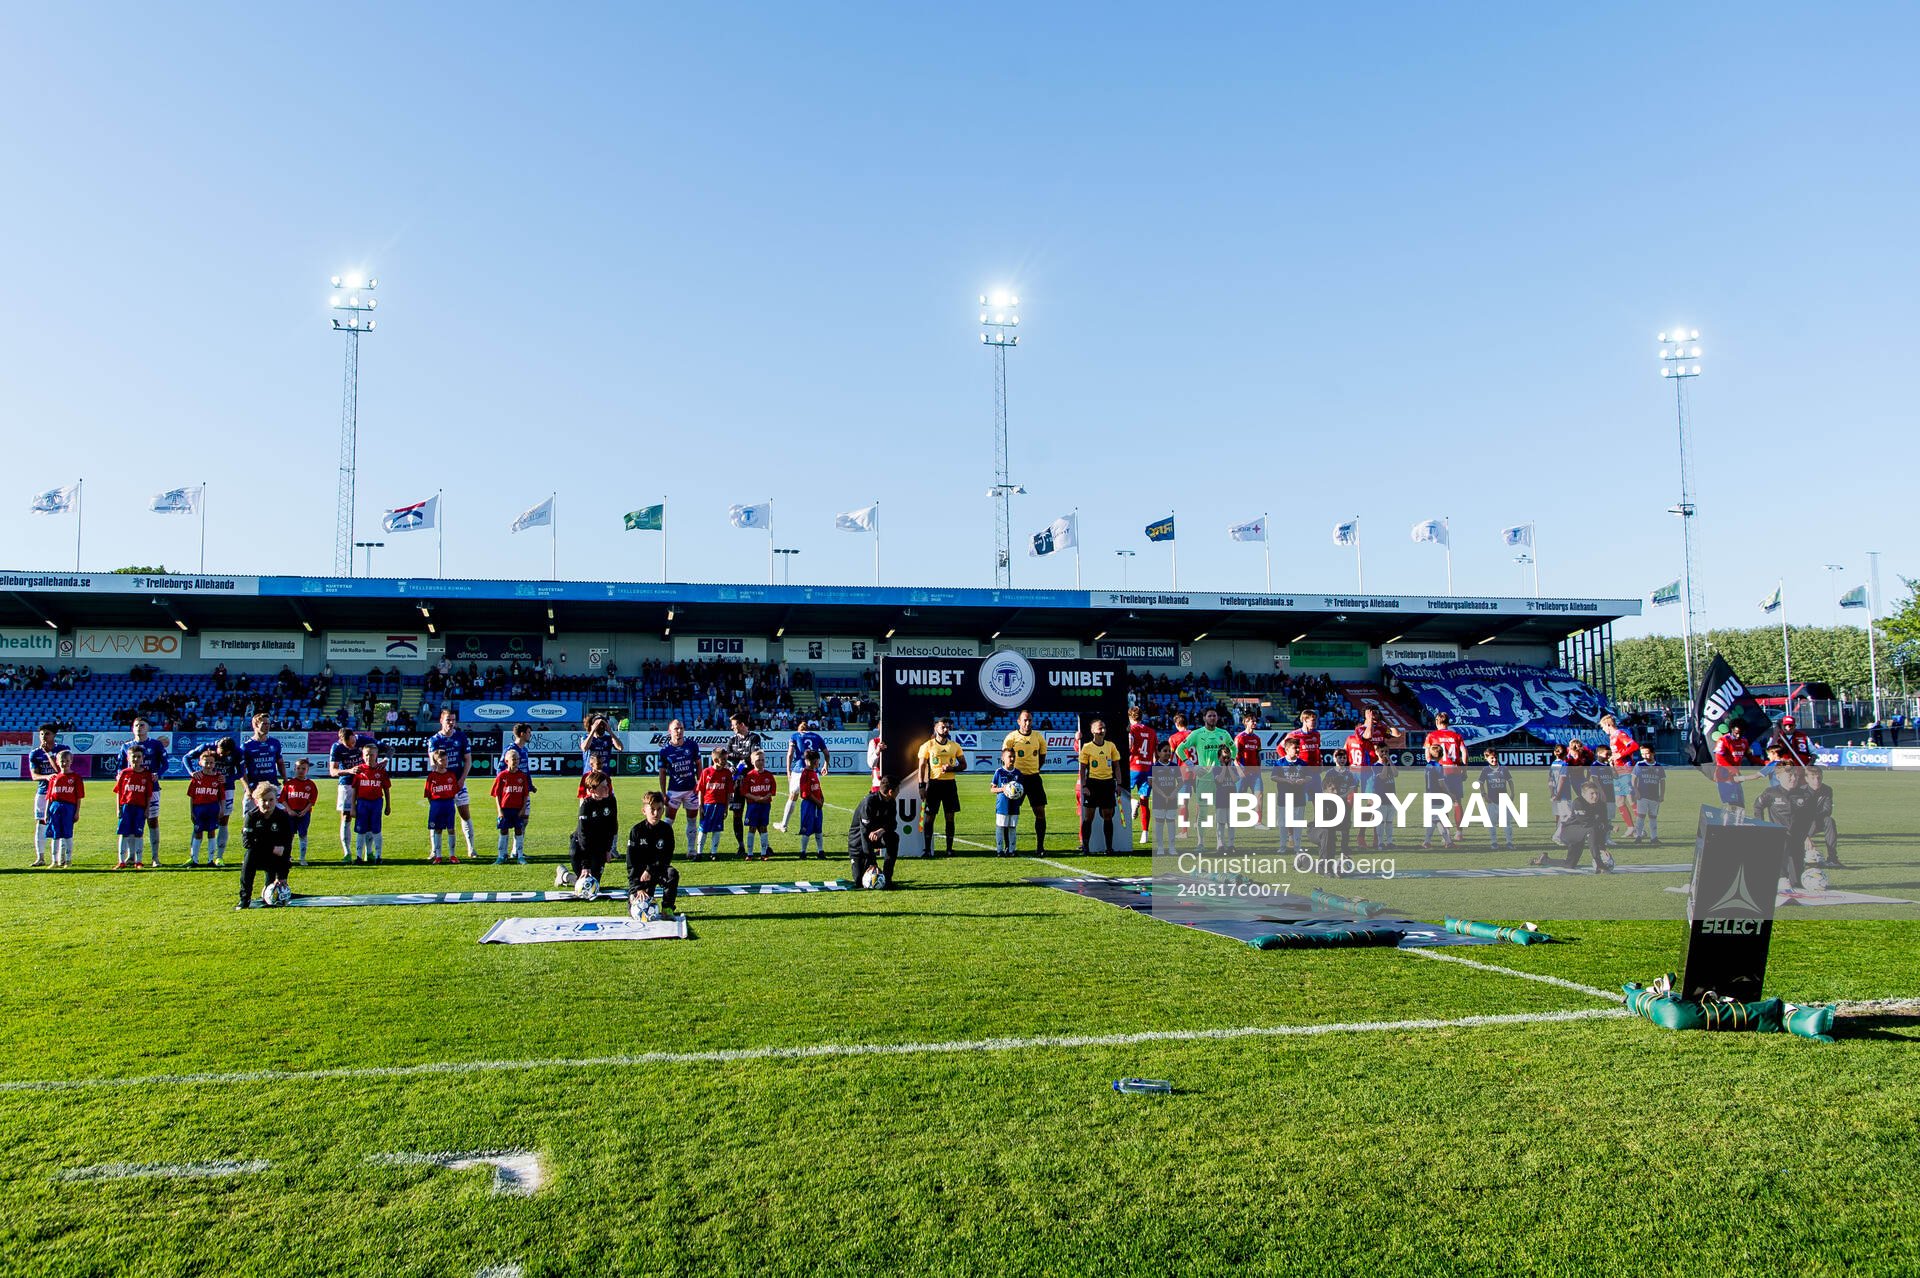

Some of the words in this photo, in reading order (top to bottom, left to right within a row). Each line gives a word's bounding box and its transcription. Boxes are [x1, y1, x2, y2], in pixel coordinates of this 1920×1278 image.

[146, 578, 193, 590] Trelleborgs
[194, 579, 235, 590] Allehanda
[1120, 594, 1156, 605] Trelleborgs
[1157, 595, 1189, 605] Allehanda
[1220, 597, 1294, 607] trelleborgsallehanda.se
[1334, 598, 1368, 609] Trelleborgs
[1369, 599, 1400, 608] Allehanda
[1428, 600, 1498, 610] trelleborgsallehanda.se
[1535, 602, 1568, 612] Trelleborgs
[1569, 602, 1598, 611] Allehanda
[0, 635, 52, 649] health
[79, 634, 178, 654] KLARABO
[221, 640, 260, 650] Trelleborgs
[261, 641, 295, 649] Allehanda
[897, 646, 973, 657] Metso:Outotec
[1117, 646, 1145, 657] ALDRIG
[1147, 646, 1174, 657] ENSAM
[1394, 650, 1427, 660] Trelleborgs
[1428, 650, 1456, 659] Allehanda
[896, 669, 965, 686] UNIBET
[1048, 671, 1114, 687] UNIBET
[381, 737, 422, 747] CRAFT
[834, 737, 865, 745] KAPITAL
[1139, 739, 1149, 758] 4
[1053, 757, 1062, 765] AB
[1498, 752, 1553, 766] UNIBET
[1860, 753, 1889, 763] OBOS
[360, 779, 369, 787] FAIR
[899, 799, 917, 823] U
[1701, 917, 1765, 935] SELECT
